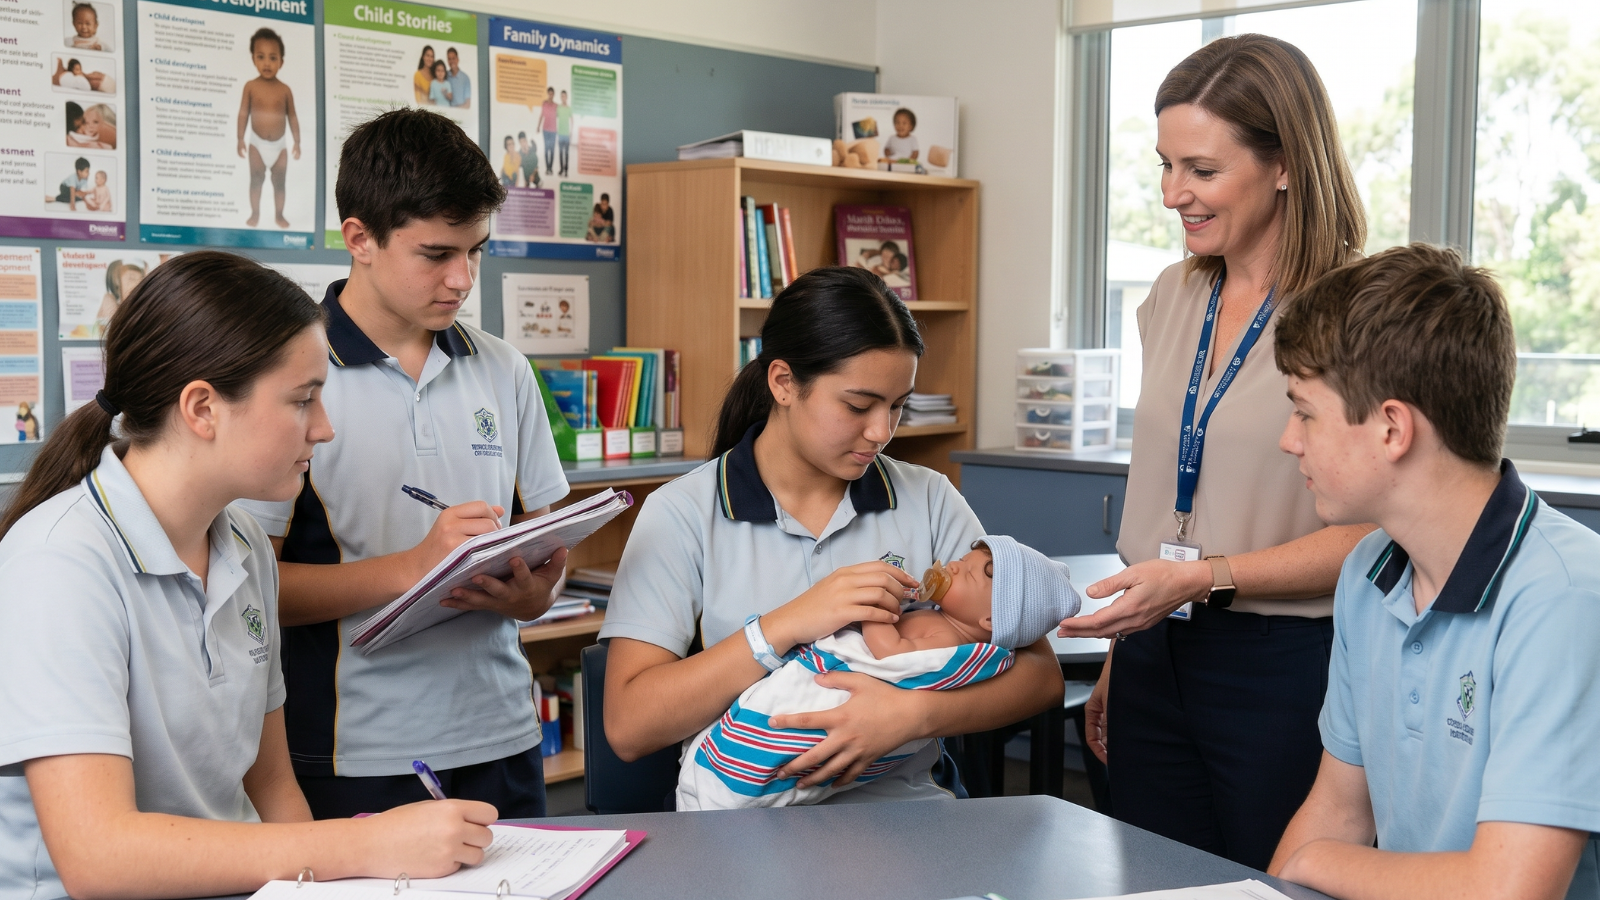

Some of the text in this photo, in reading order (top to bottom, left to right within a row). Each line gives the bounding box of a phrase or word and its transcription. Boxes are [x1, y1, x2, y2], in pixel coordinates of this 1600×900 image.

[204, 0, 307, 16] velopment
[354, 4, 394, 25] Child
[503, 25, 611, 55] Family Dynamics
